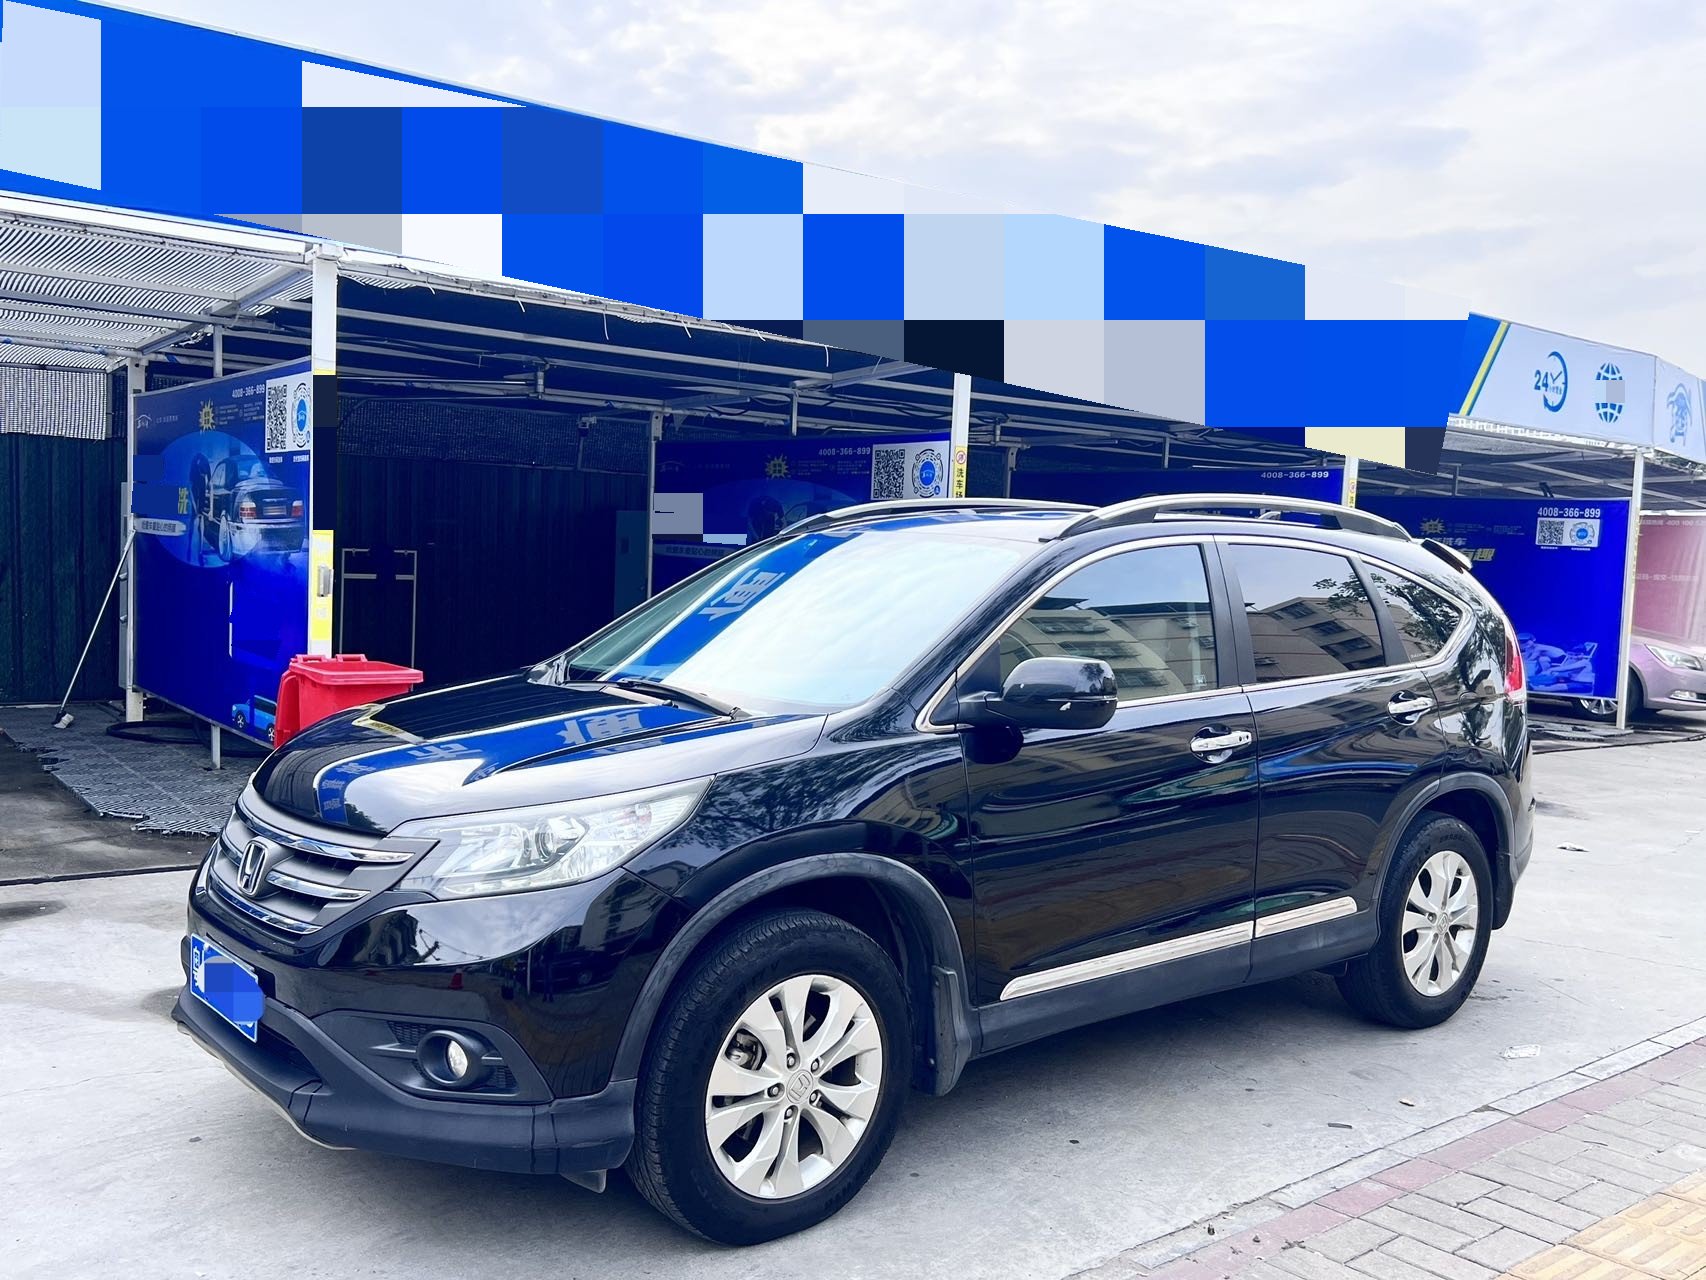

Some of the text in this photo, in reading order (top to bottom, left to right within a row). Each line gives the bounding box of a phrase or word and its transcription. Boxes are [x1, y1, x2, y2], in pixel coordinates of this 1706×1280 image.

[1534, 369, 1548, 392] 24
[232, 384, 265, 398] 4008-366-899
[818, 447, 871, 456] 4008-366-899
[1261, 470, 1329, 479] 4008-366-899
[1537, 507, 1601, 518] 4008-366-899
